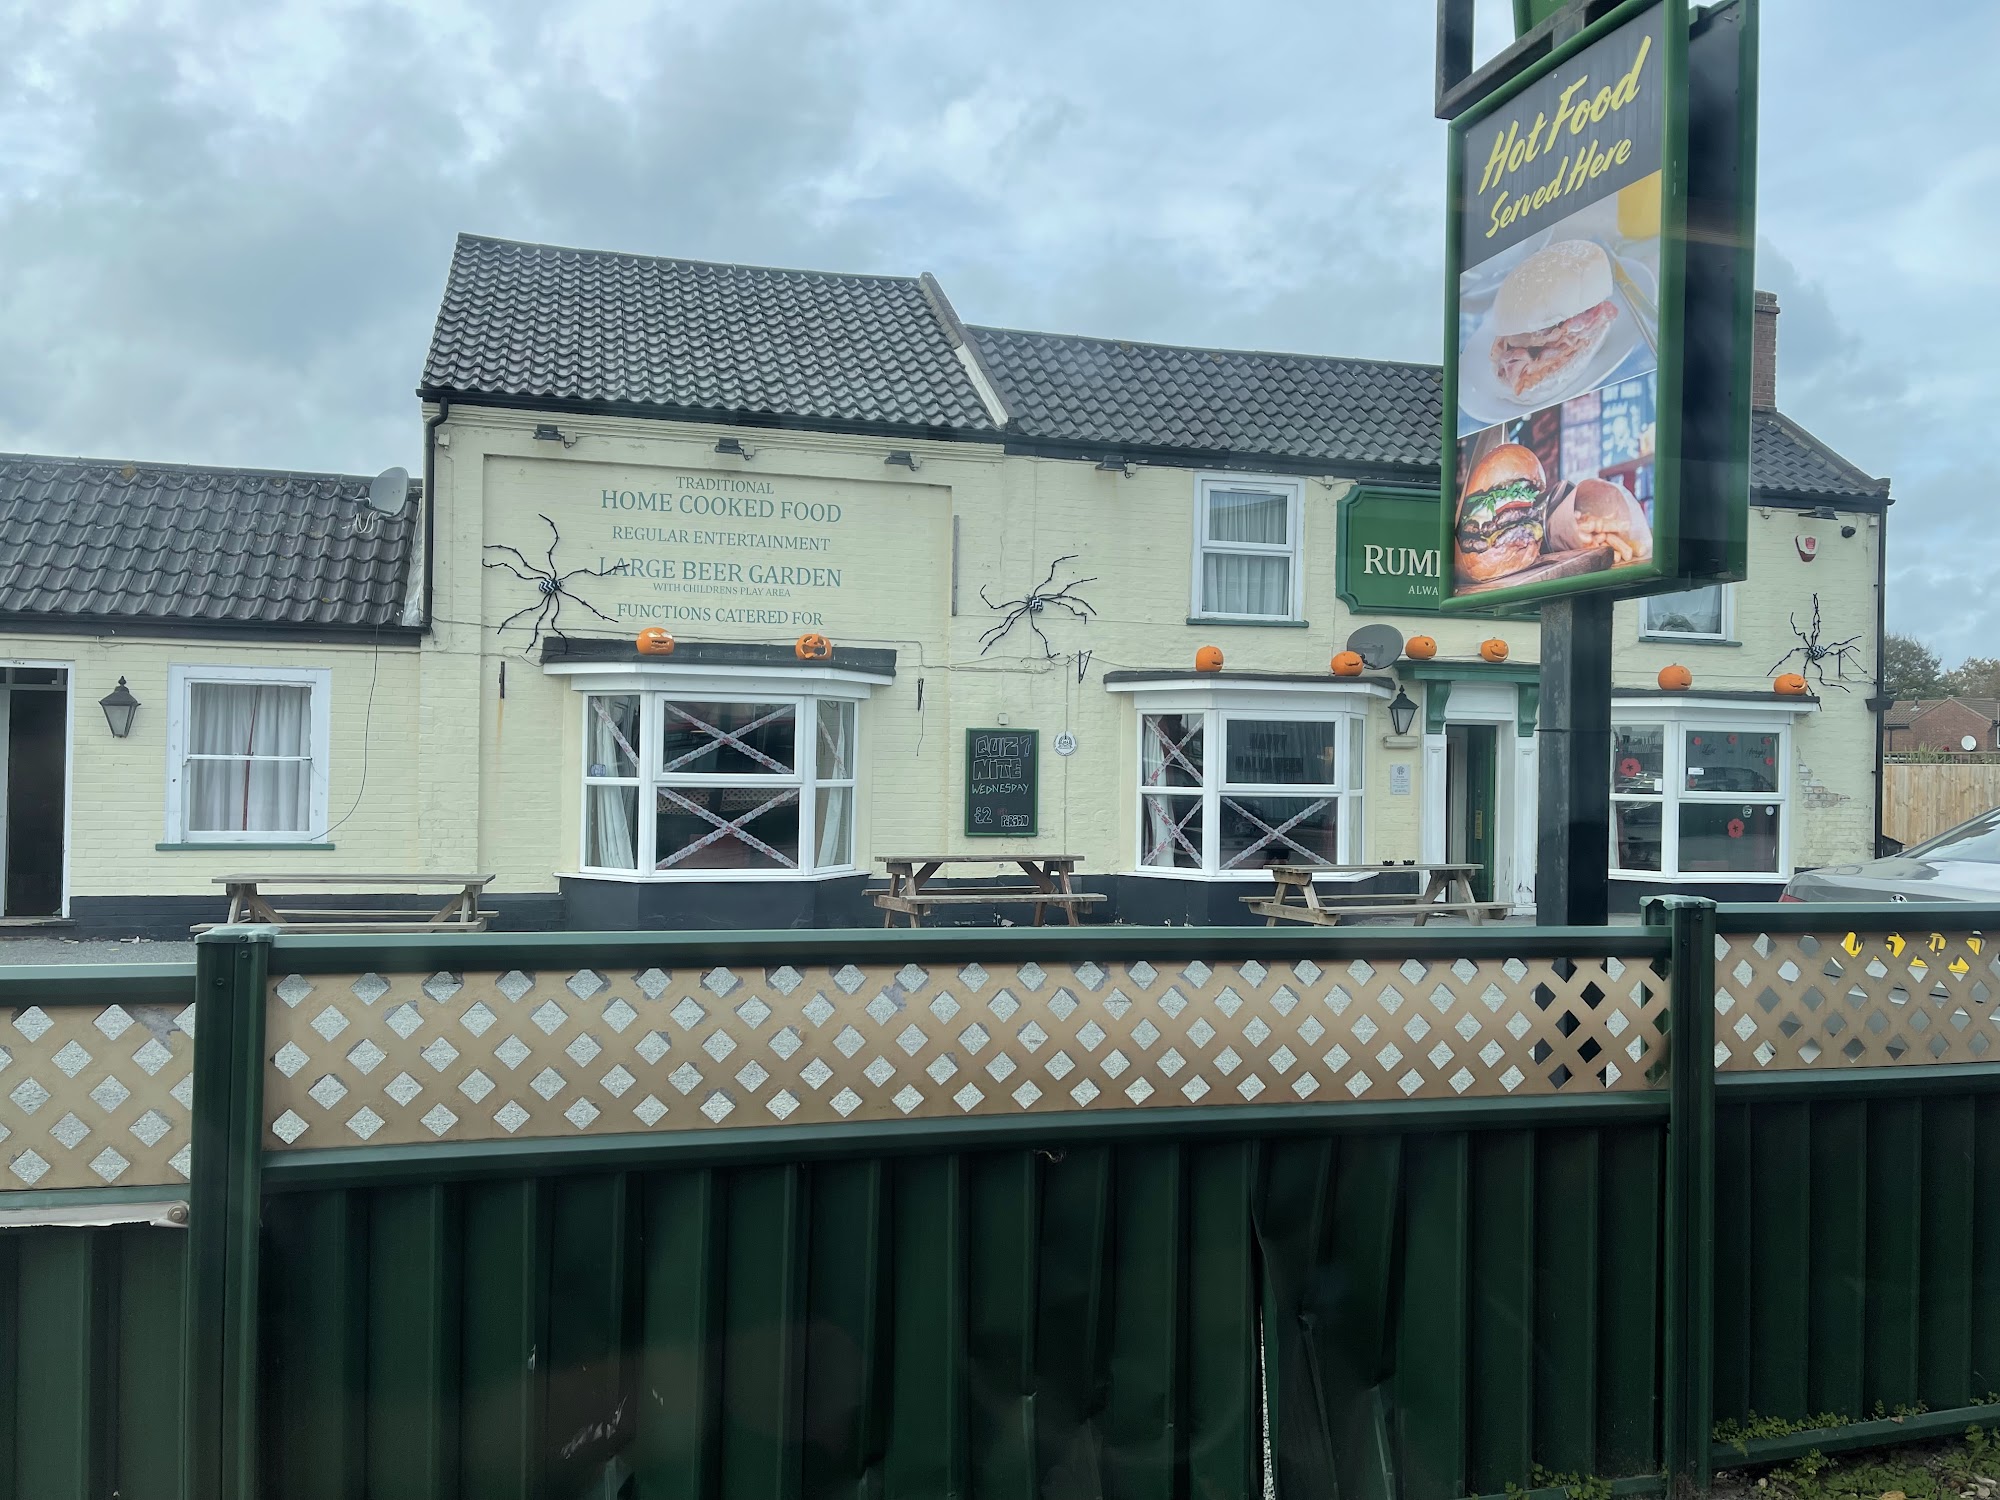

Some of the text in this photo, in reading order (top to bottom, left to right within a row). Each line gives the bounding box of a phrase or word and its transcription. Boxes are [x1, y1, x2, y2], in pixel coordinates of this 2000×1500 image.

[1478, 35, 1652, 195] Hot Food
[1485, 138, 1632, 238] Served Here
[676, 476, 775, 494] TRADITIONAL
[601, 489, 842, 523] HOME COOKED FOOD
[612, 526, 831, 551] REGULAR ENTERTAINMENT
[599, 556, 843, 587] LARGE BEER GARDEN
[1363, 544, 1440, 577] RUM
[652, 582, 792, 597] WITH CHILDRENS PLAY AREA
[1408, 585, 1439, 596] ALWA
[617, 603, 824, 626] FUNCTIONS CATERED FOR
[975, 735, 1018, 758] QUIZ
[972, 758, 1022, 780] NITE
[971, 783, 1030, 795] WEDNESDAY
[974, 806, 993, 824] £2
